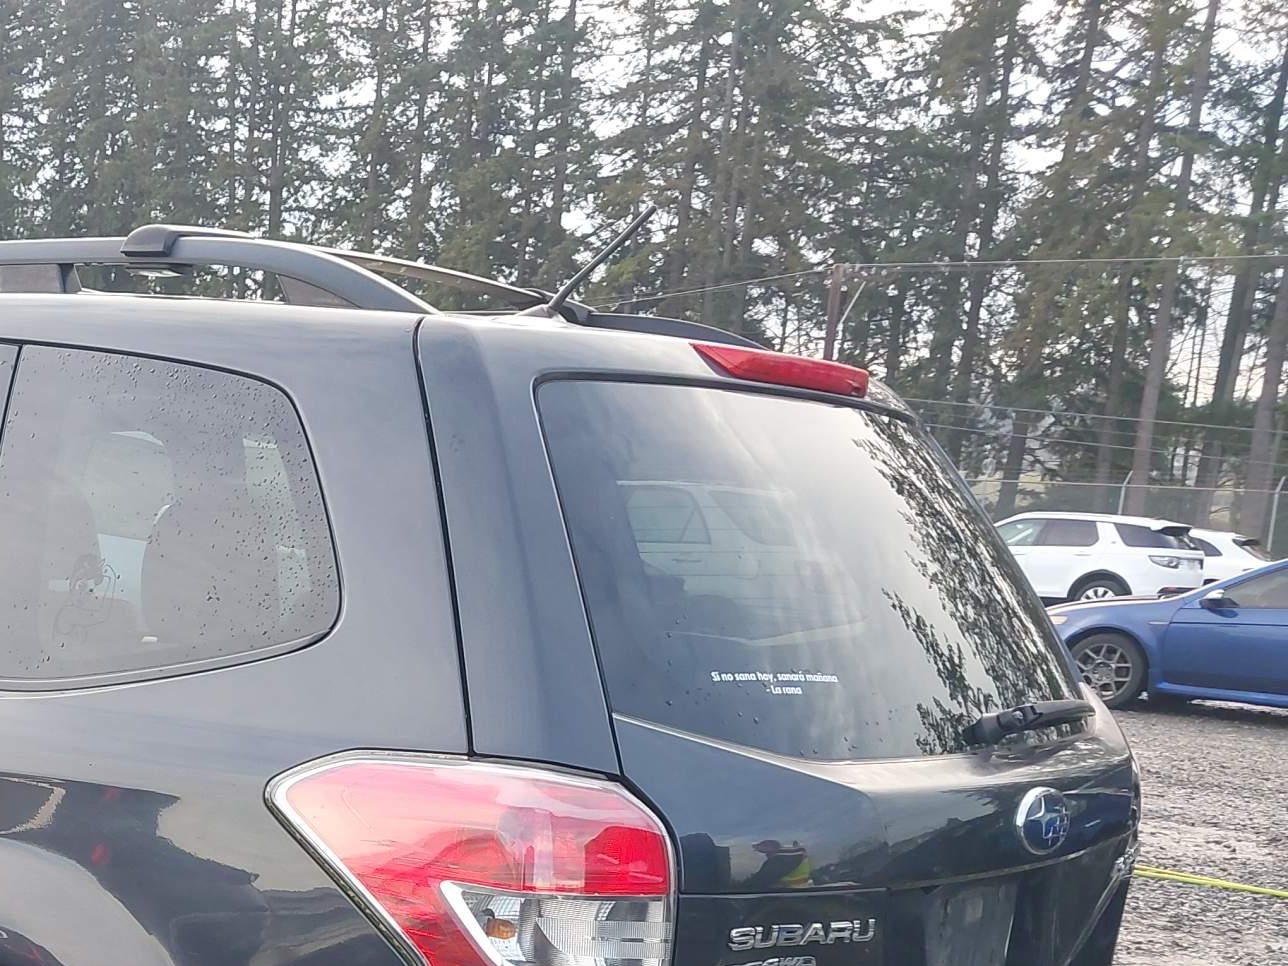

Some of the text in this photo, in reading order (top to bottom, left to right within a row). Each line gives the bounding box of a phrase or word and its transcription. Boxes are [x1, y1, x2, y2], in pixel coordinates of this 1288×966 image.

[710, 671, 721, 682] Si
[721, 672, 734, 682] no
[734, 672, 757, 682] sana
[777, 670, 806, 682] sanará
[806, 671, 839, 683] mañana
[771, 684, 782, 695] La
[782, 686, 803, 695] rana
[727, 917, 877, 952] SUBARU
